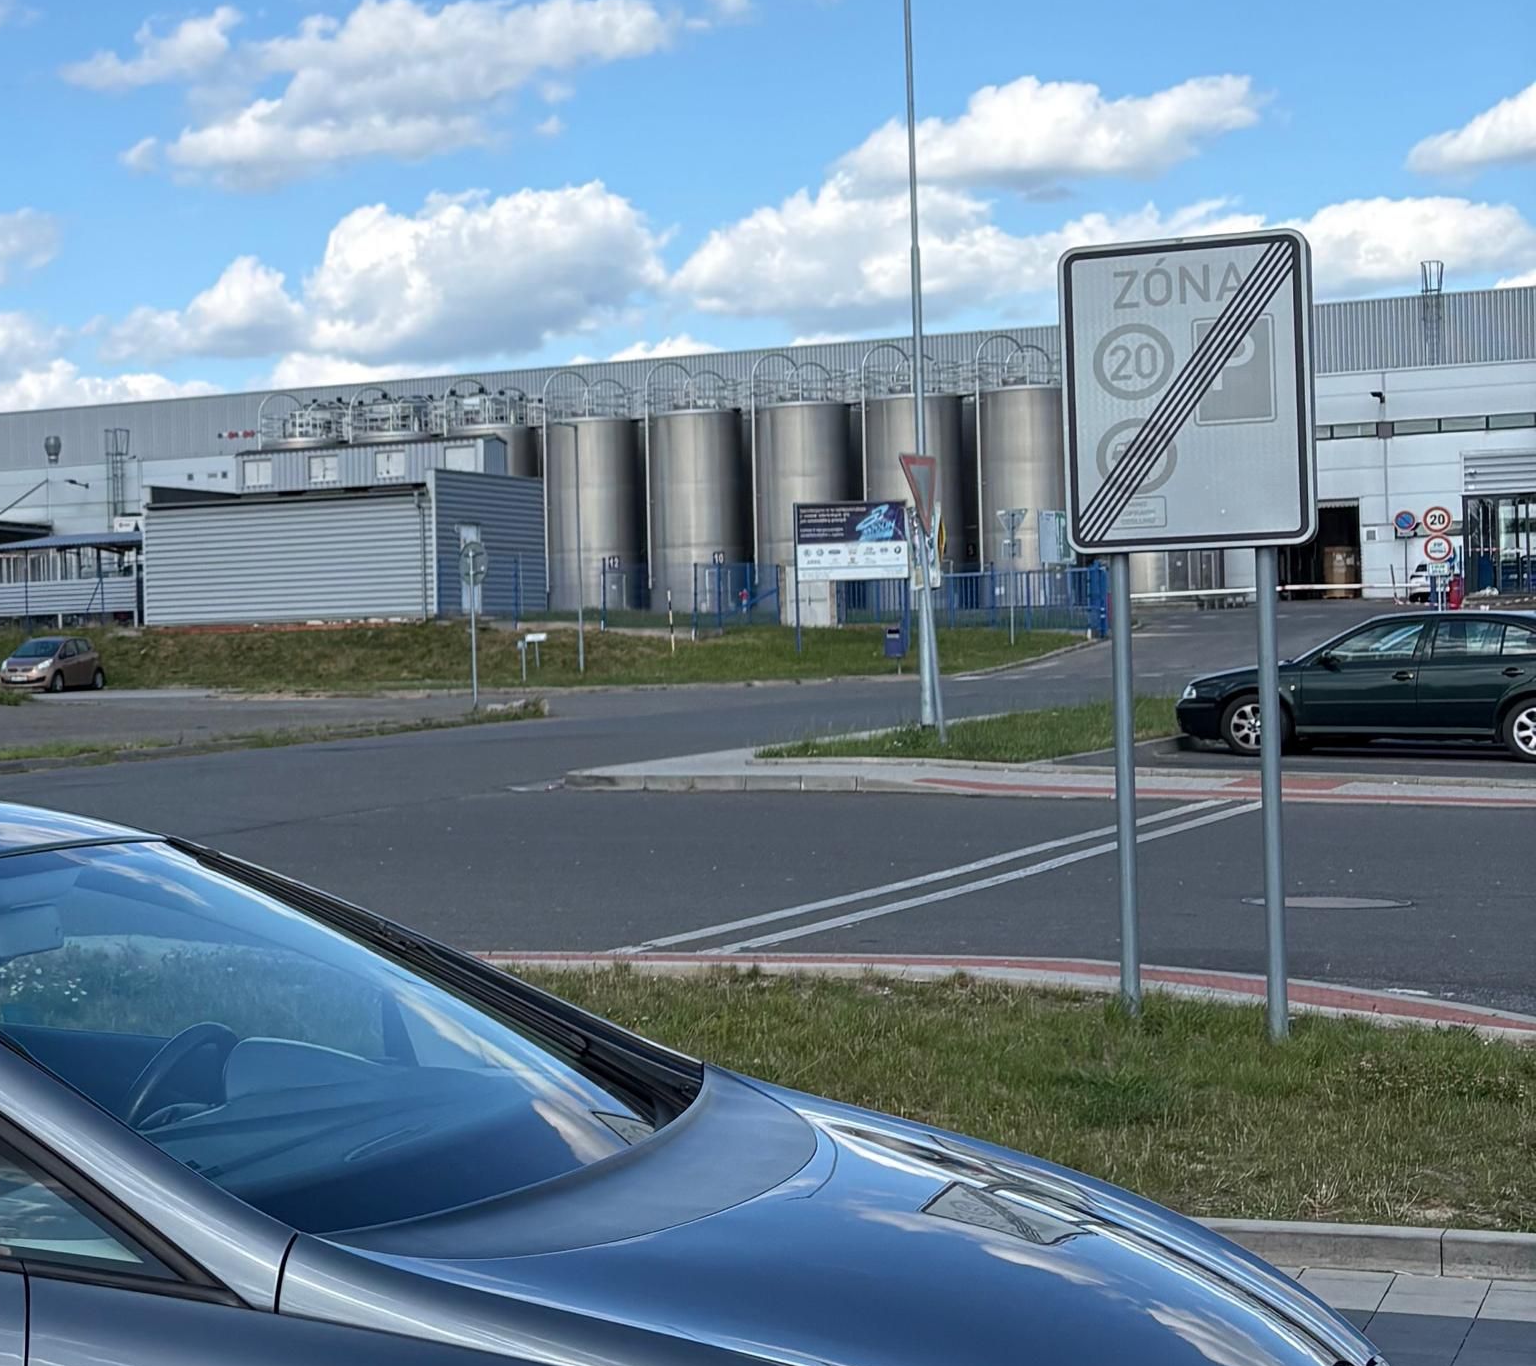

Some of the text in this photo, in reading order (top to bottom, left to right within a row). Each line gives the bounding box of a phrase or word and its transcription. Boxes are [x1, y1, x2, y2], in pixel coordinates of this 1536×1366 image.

[1113, 256, 1247, 310] ZÓNA
[1109, 342, 1158, 383] 20
[1429, 513, 1446, 526] 20
